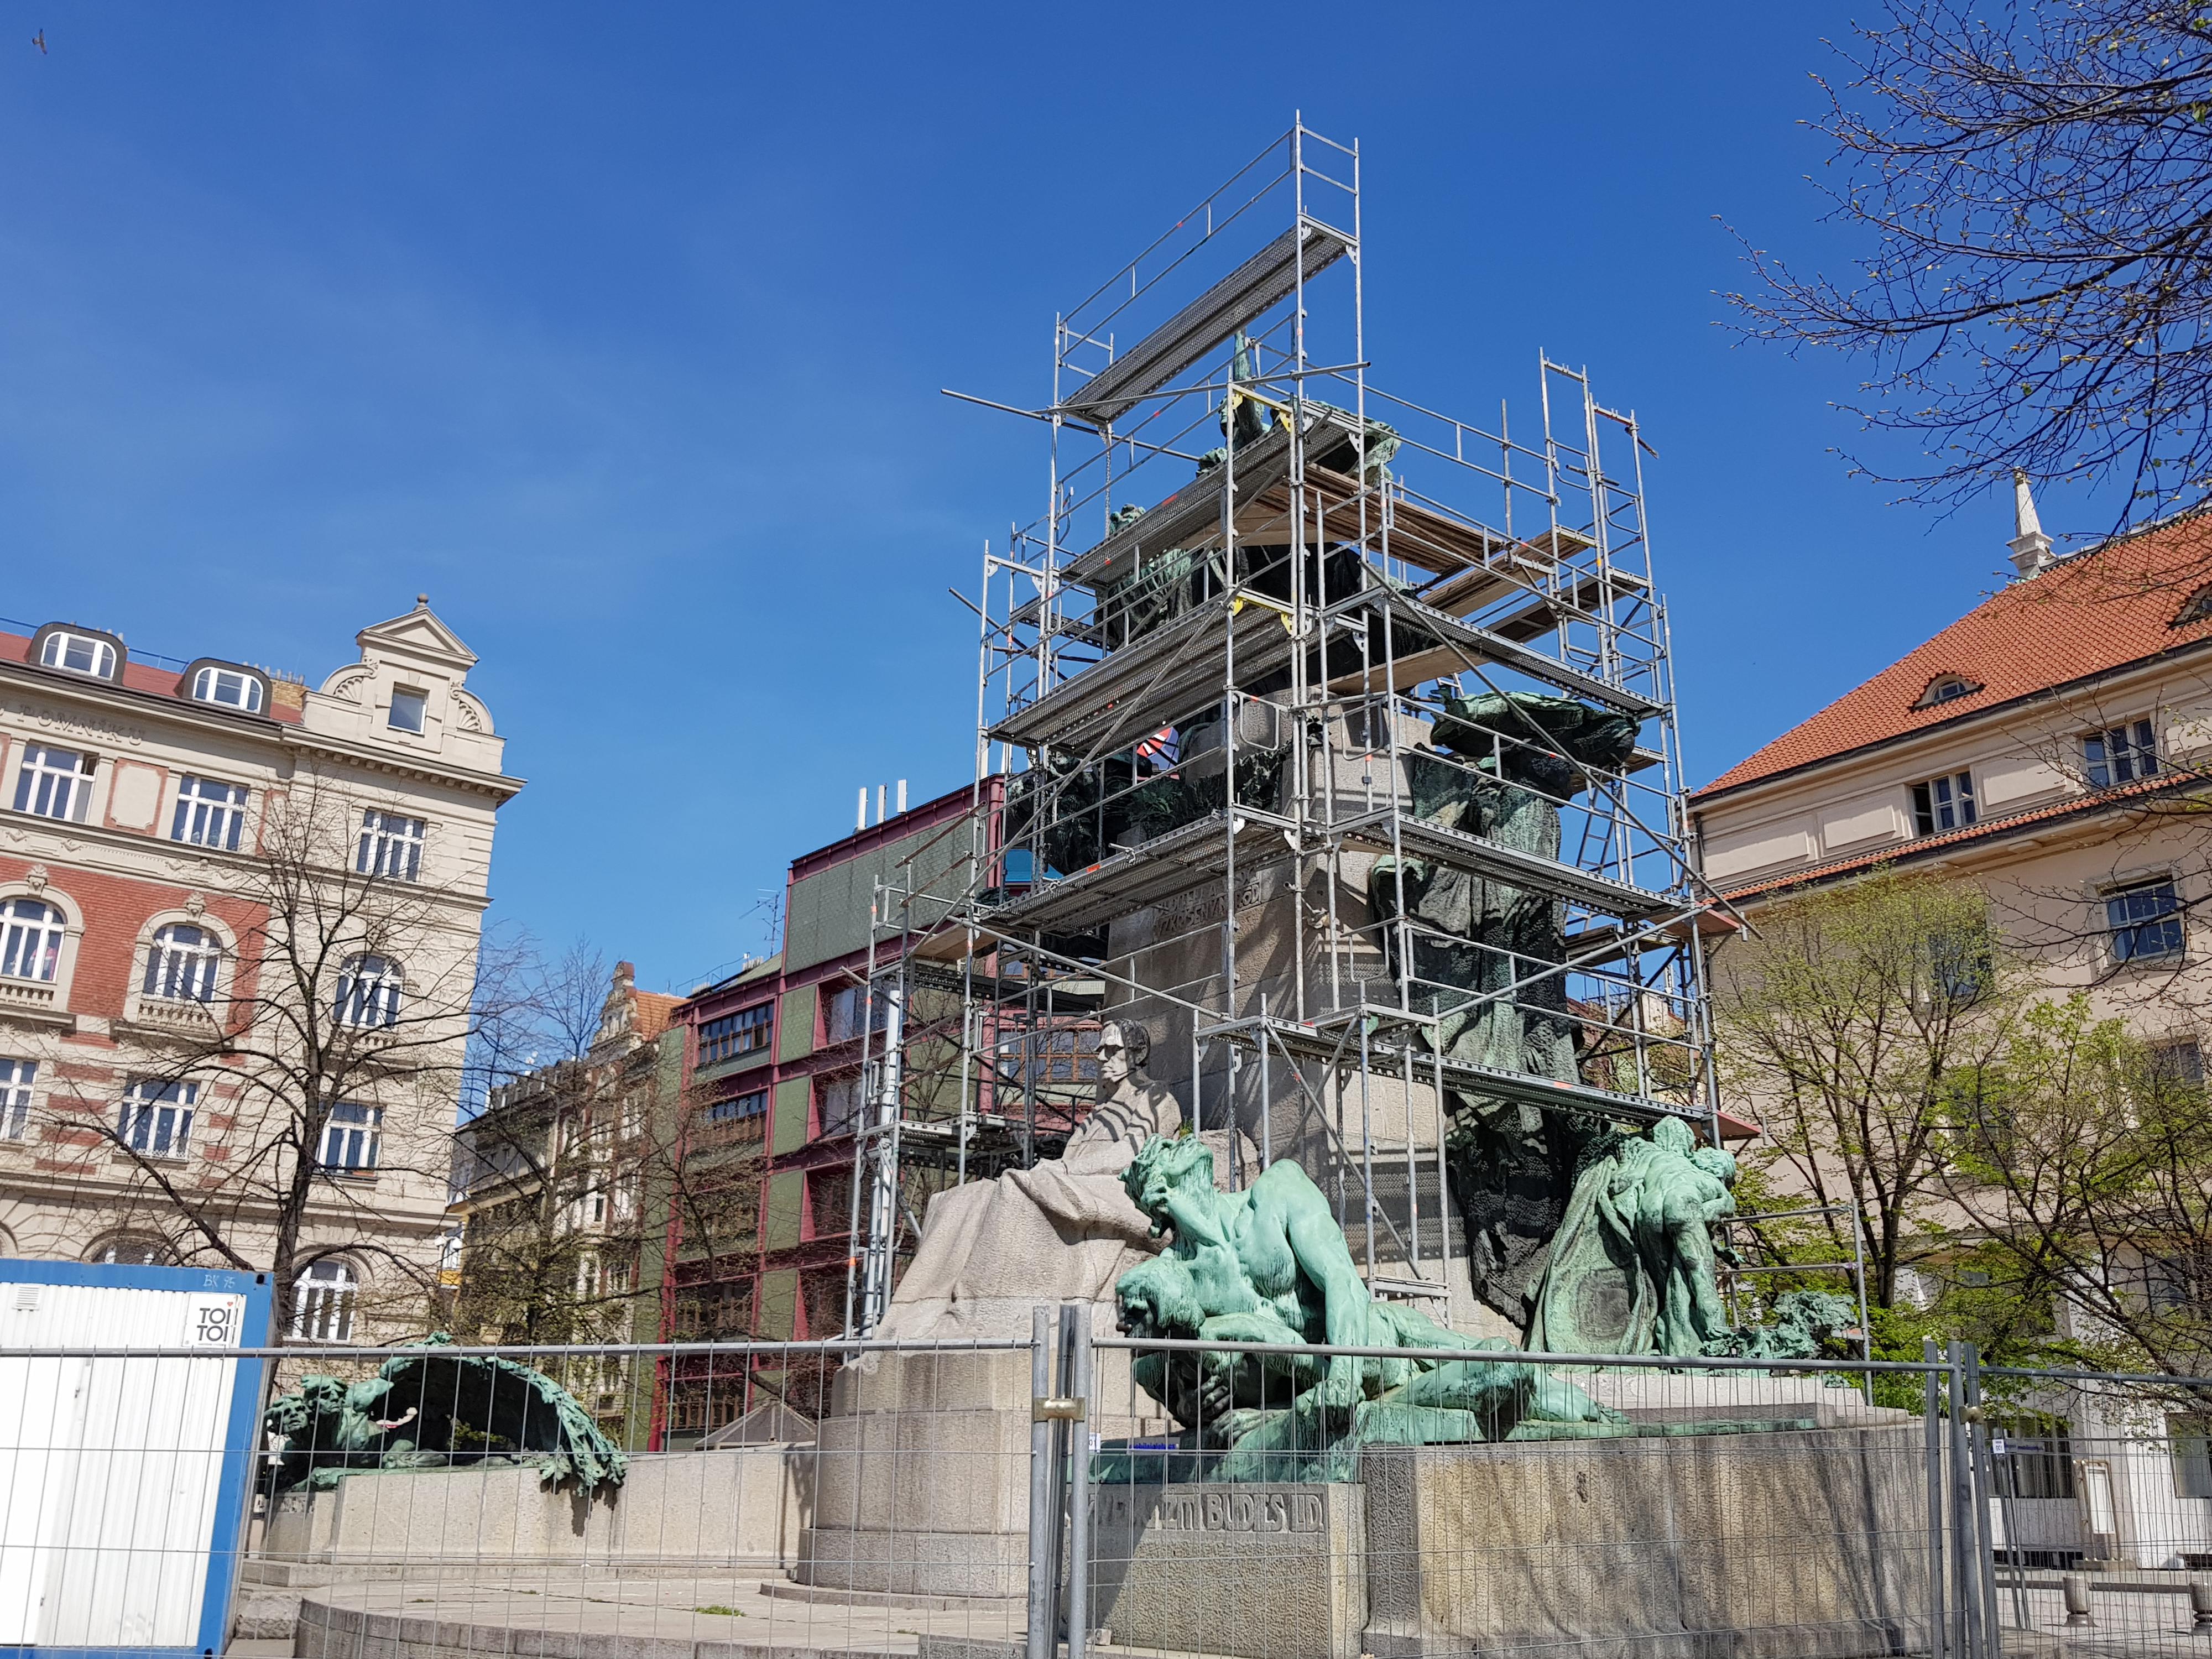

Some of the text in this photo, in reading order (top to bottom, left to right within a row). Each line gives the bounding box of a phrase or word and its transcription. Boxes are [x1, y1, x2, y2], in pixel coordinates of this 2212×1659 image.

[203, 1274, 219, 1287] BK
[199, 1307, 231, 1324] TOI
[196, 1324, 228, 1342] TOI
